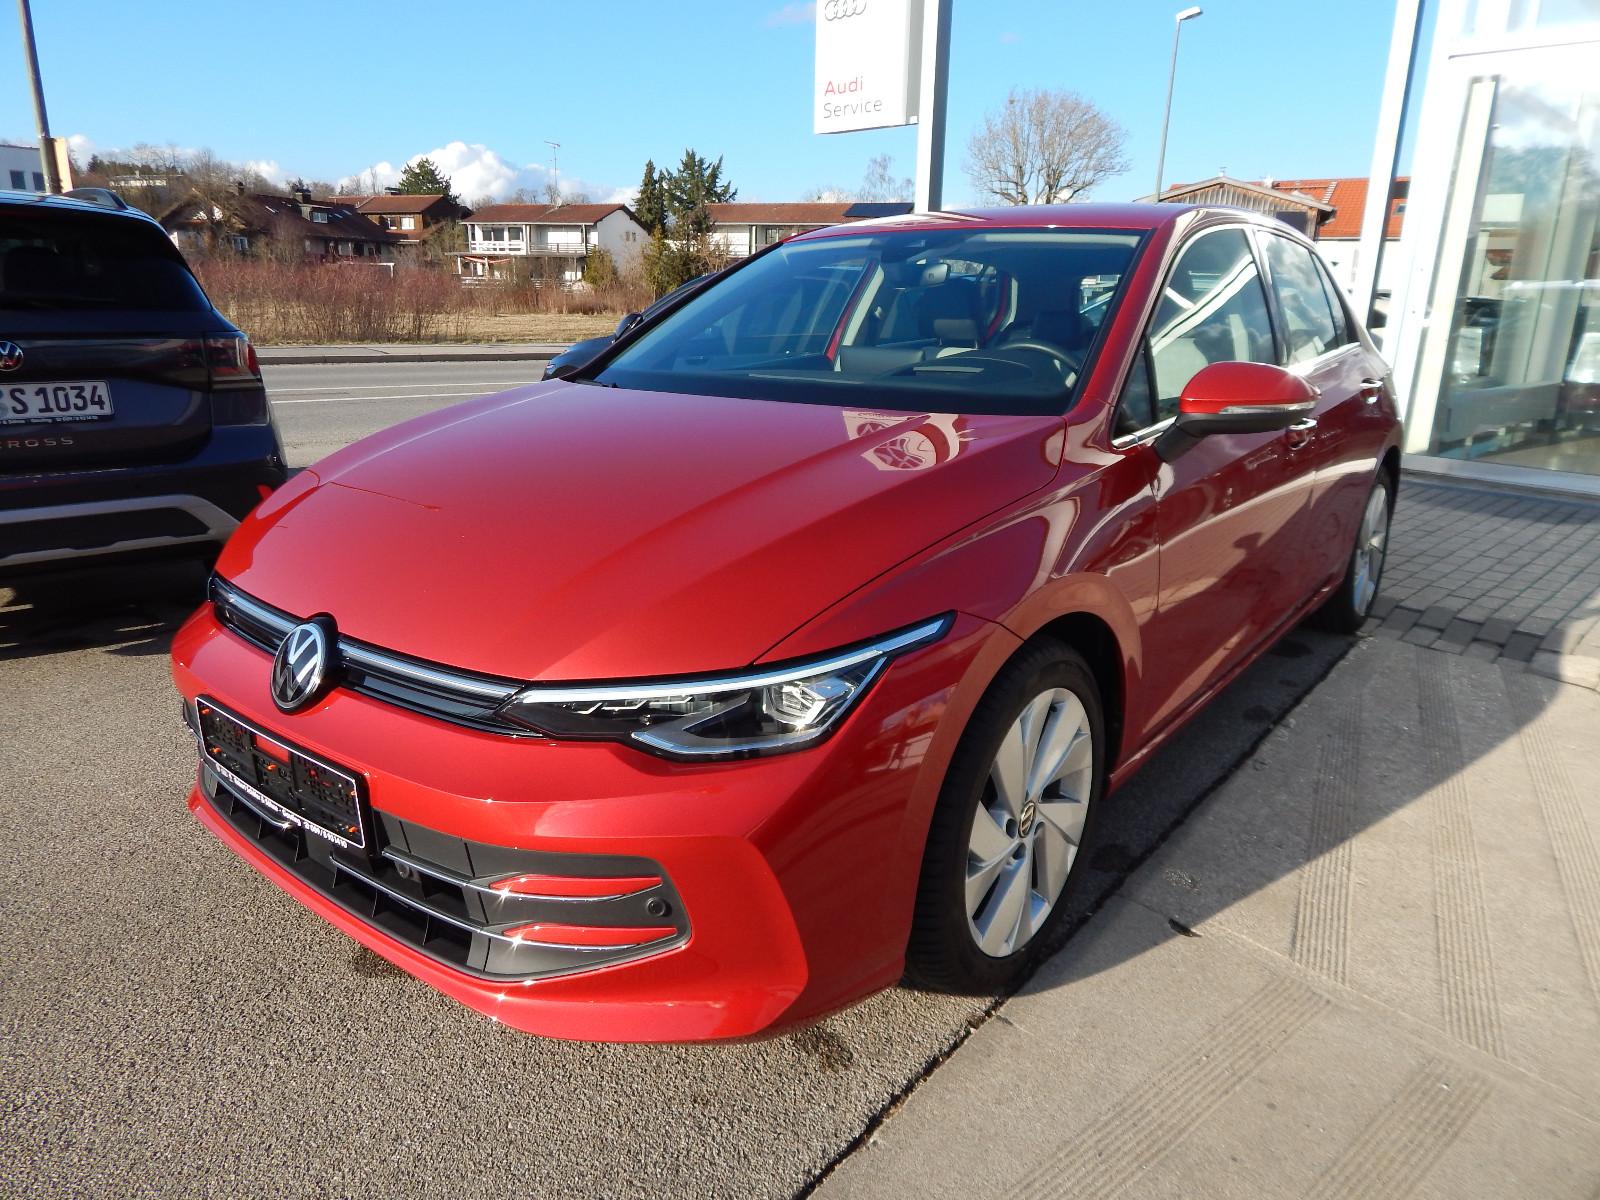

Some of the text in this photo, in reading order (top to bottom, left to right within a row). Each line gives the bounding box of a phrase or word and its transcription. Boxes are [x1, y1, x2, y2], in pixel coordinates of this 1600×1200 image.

[824, 76, 863, 96] Audi
[823, 100, 882, 119] Service
[9, 385, 105, 415] S 1034
[0, 437, 74, 449] ROSS
